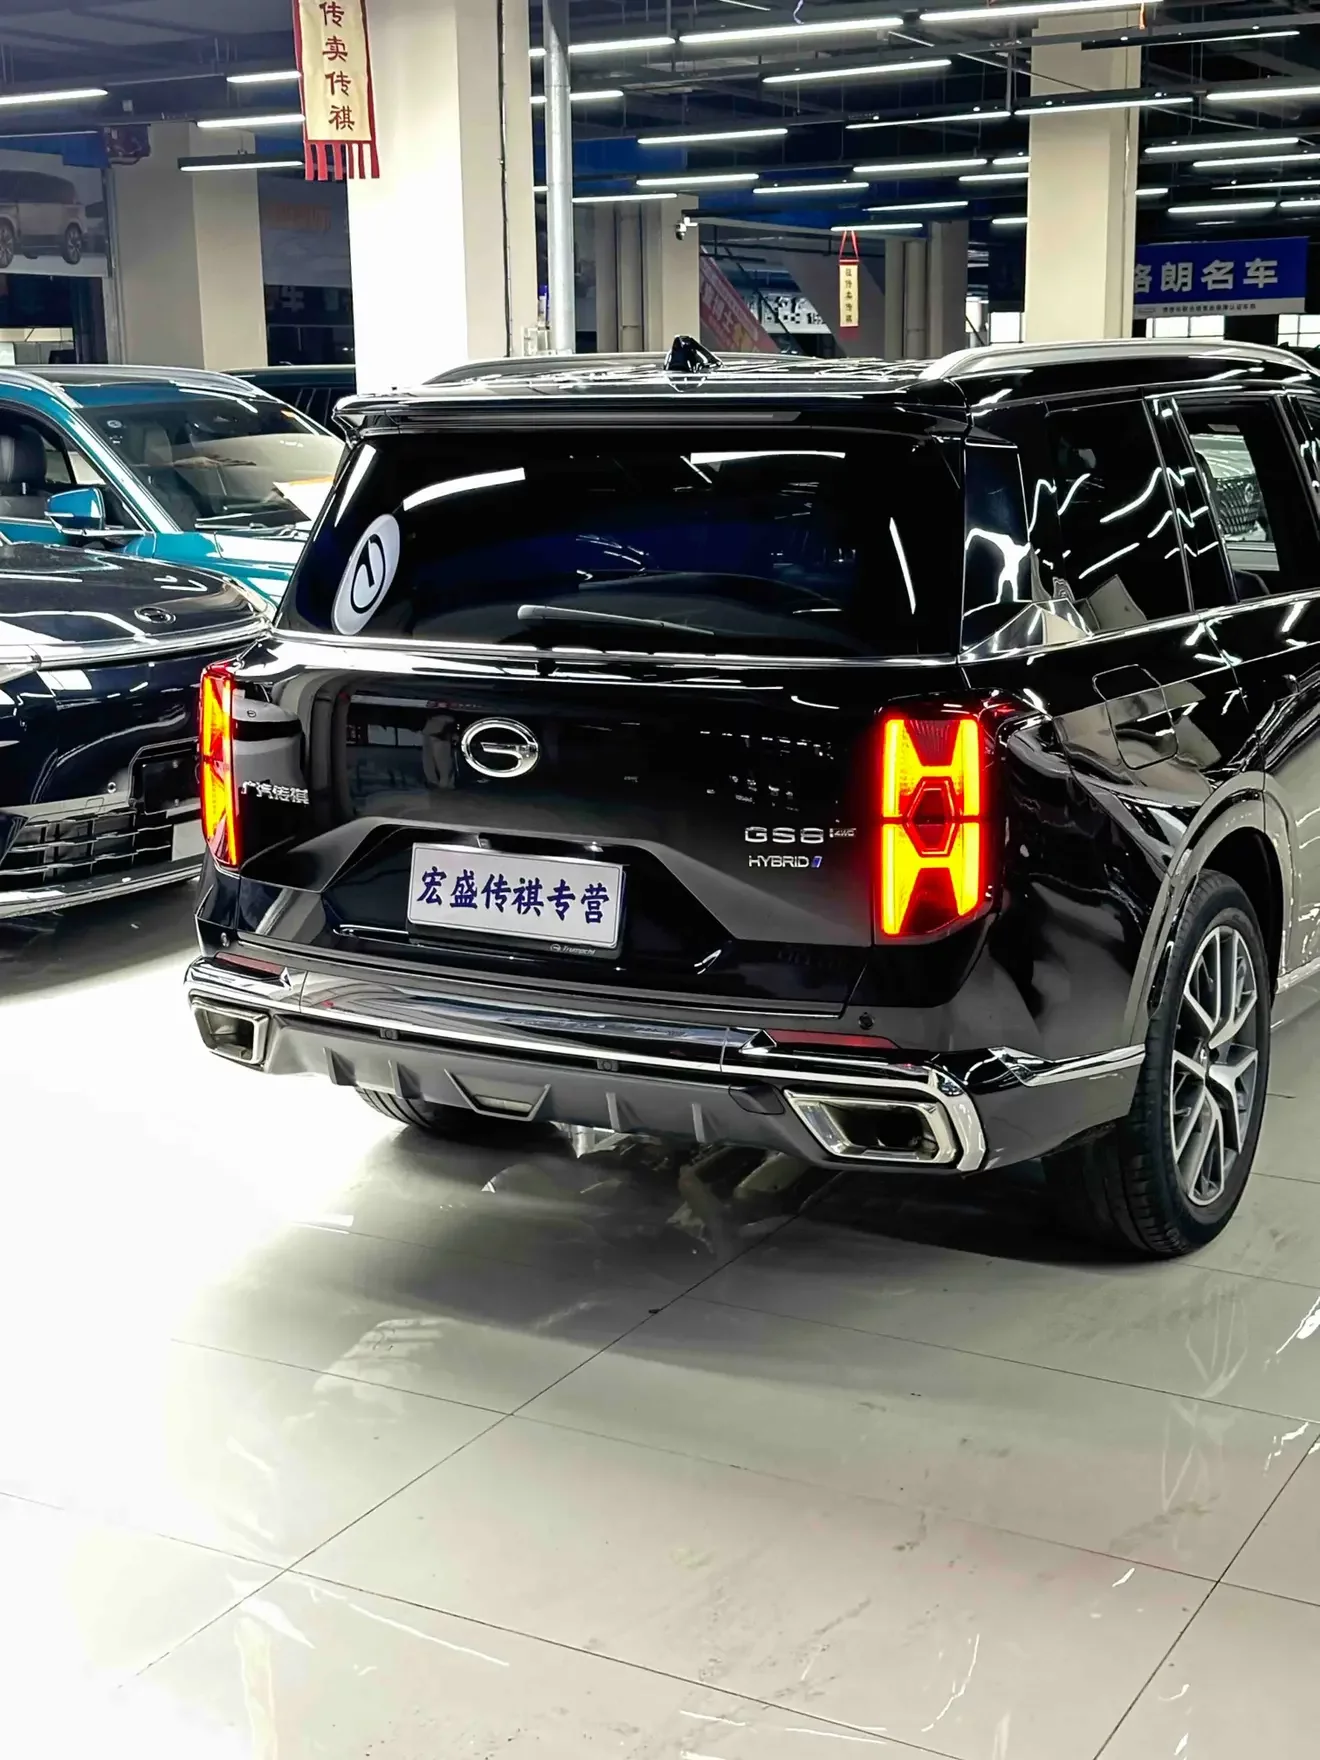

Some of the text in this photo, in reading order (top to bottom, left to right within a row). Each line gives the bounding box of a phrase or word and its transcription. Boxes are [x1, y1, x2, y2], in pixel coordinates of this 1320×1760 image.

[319, 1, 355, 131] 传卖传祺
[745, 826, 824, 844] GS8
[748, 855, 810, 868] HYBRID
[416, 866, 610, 924] 宏盛传祺专营
